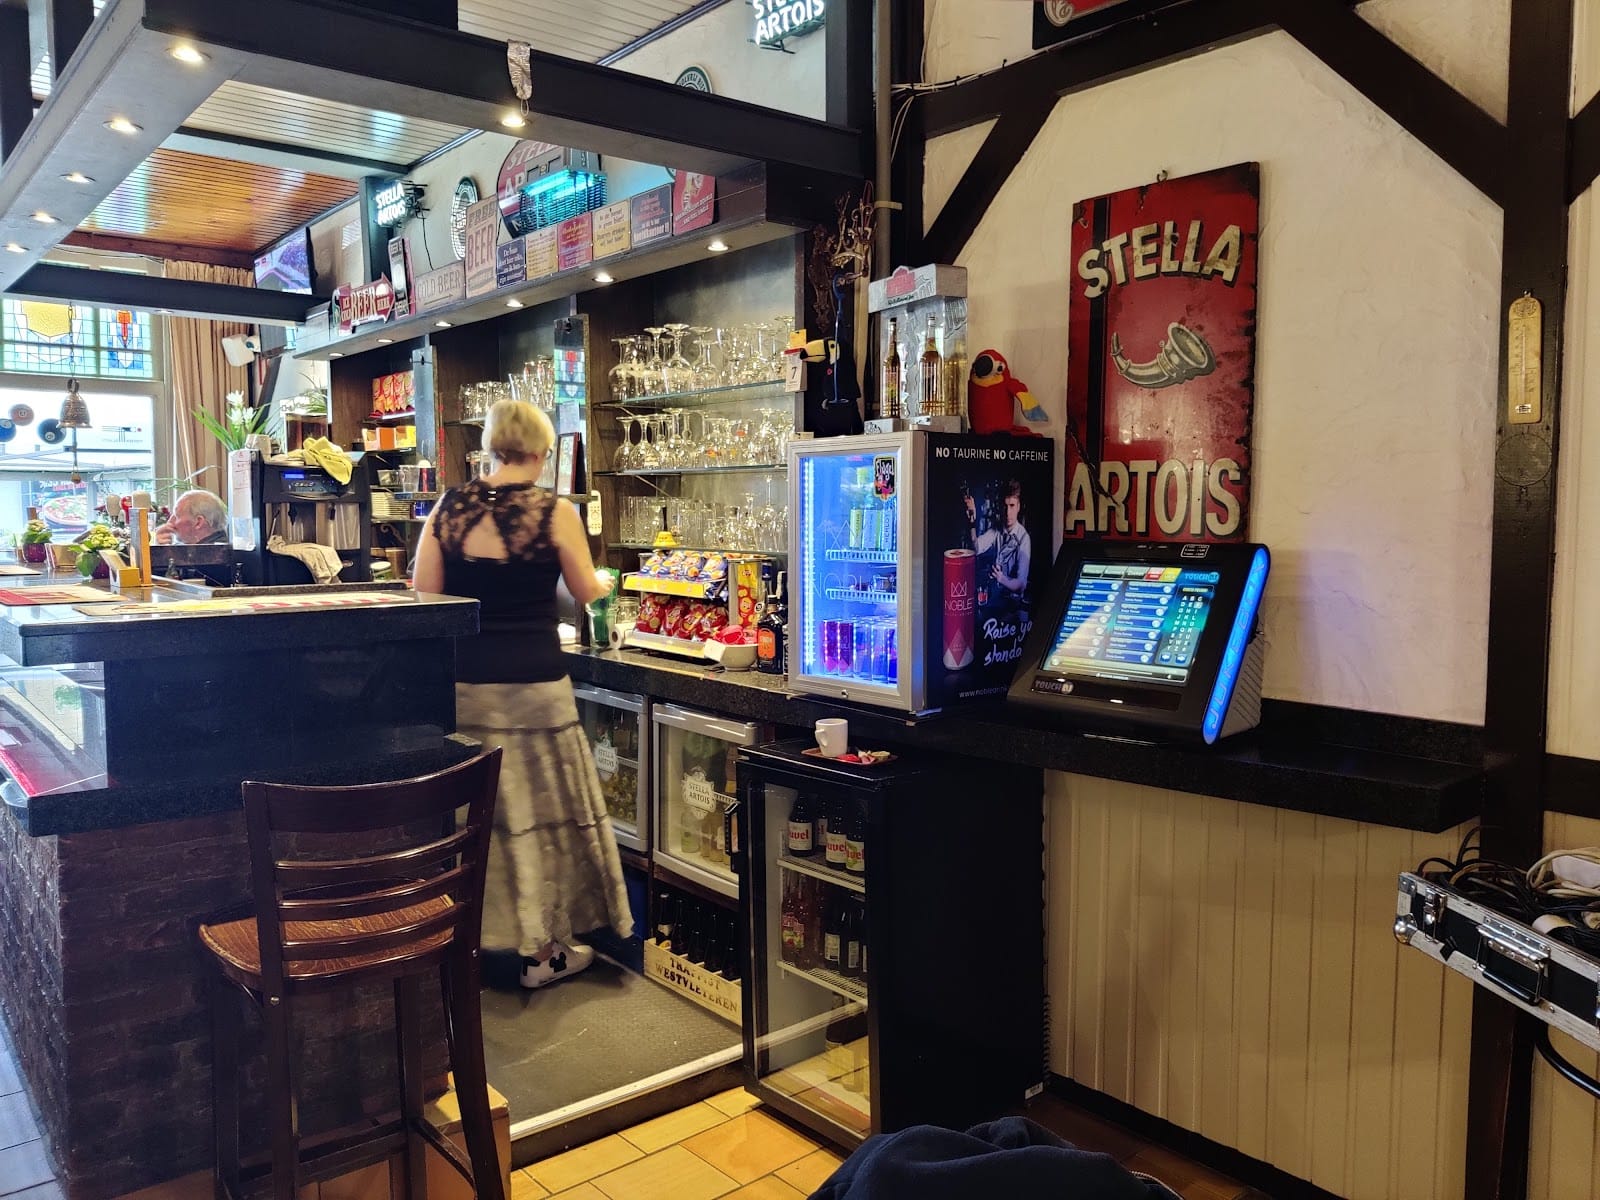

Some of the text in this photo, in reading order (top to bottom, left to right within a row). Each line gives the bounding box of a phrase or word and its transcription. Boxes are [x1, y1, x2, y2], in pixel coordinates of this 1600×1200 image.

[755, 0, 824, 45] ARTOIS
[376, 182, 405, 209] STELLA
[378, 200, 406, 226] ARTOIS
[468, 223, 494, 272] BEER
[1077, 220, 1241, 299] STELLA
[417, 278, 437, 299] COLD
[437, 270, 461, 294] BEER
[351, 286, 376, 320] BEER
[791, 366, 798, 380] 7
[936, 447, 1049, 462] NO TAURINE NO CAFFEINE
[1065, 458, 1241, 536] ARTOIS
[944, 598, 973, 612] NOBLE
[983, 618, 1017, 640] Raise
[689, 783, 710, 796] STELLA
[689, 792, 710, 804] ARTOIS
[789, 829, 809, 840] uvel
[827, 841, 847, 852] uvel
